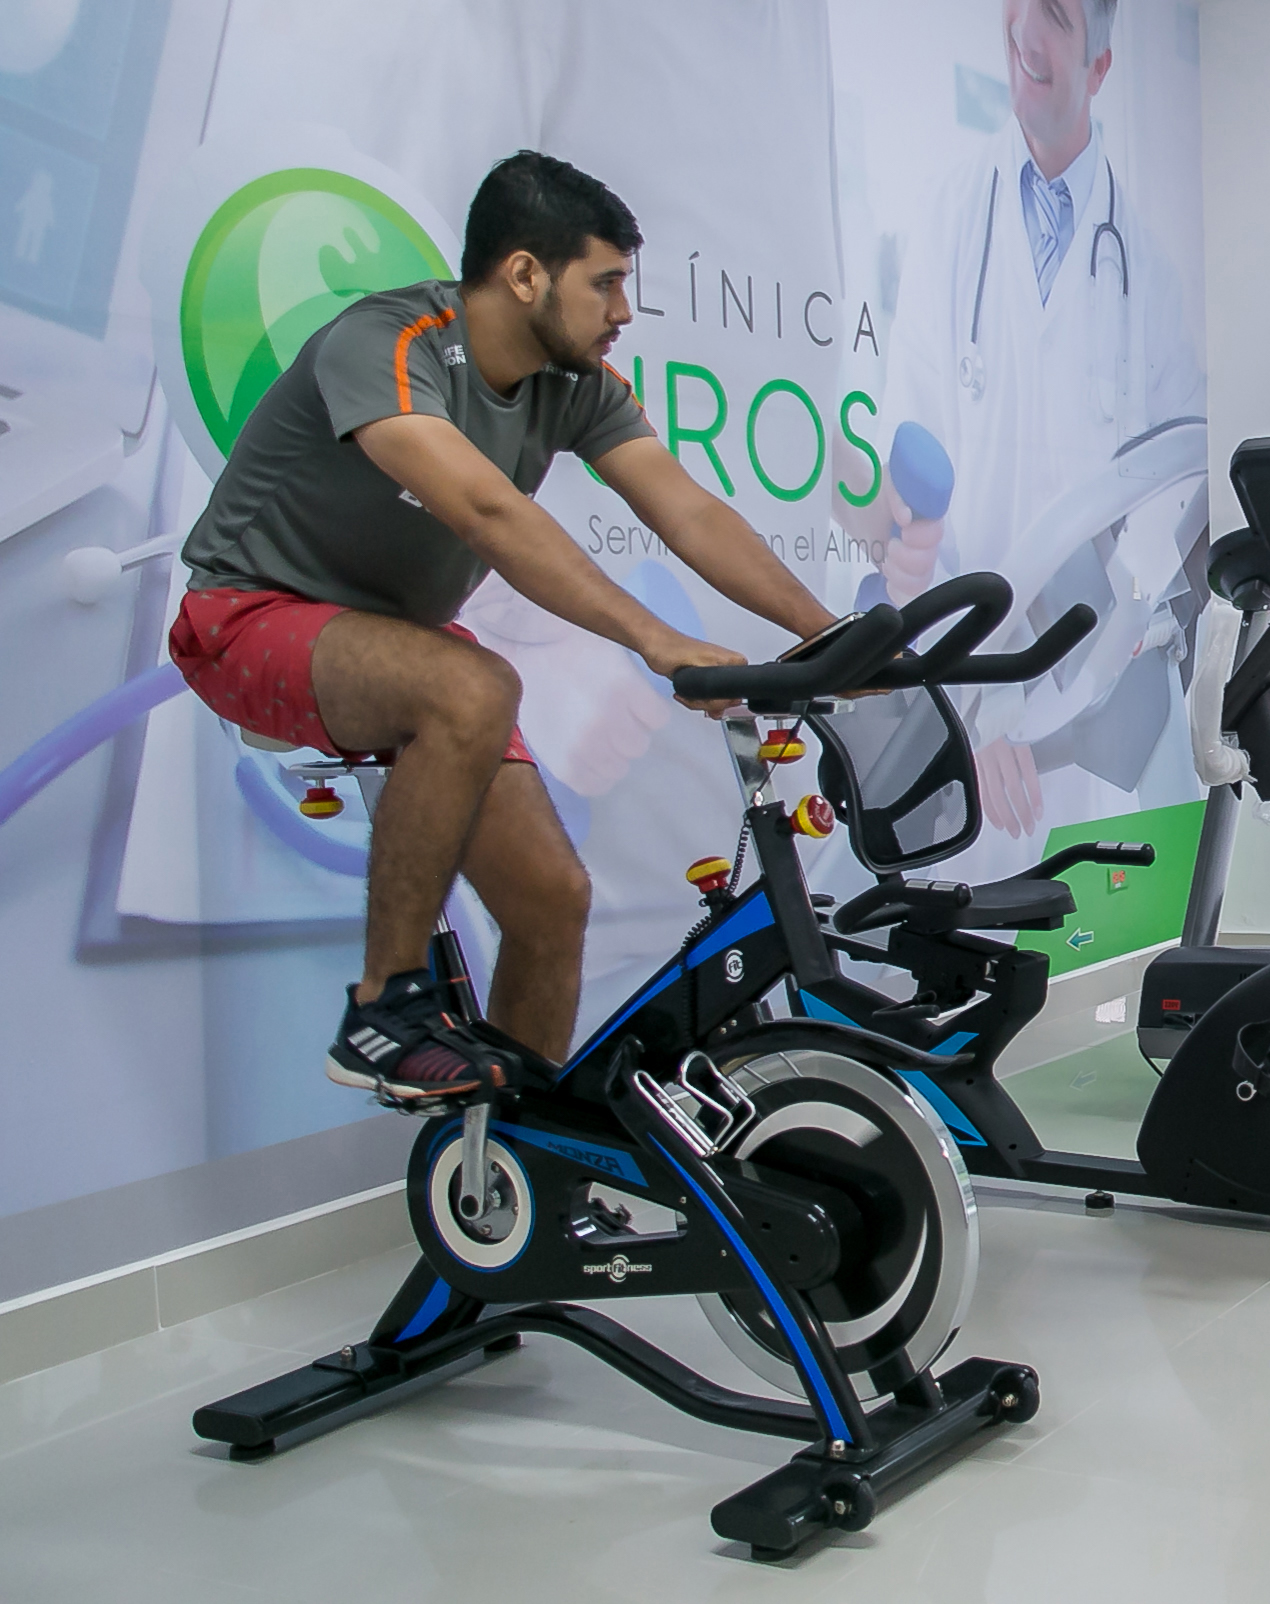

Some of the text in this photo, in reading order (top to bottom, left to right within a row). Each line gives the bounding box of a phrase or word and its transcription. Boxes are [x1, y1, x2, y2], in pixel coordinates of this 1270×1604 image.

[635, 250, 879, 356] LÍNICA
[588, 514, 668, 555] Servi
[794, 527, 815, 562] el
[824, 529, 885, 564] Alma
